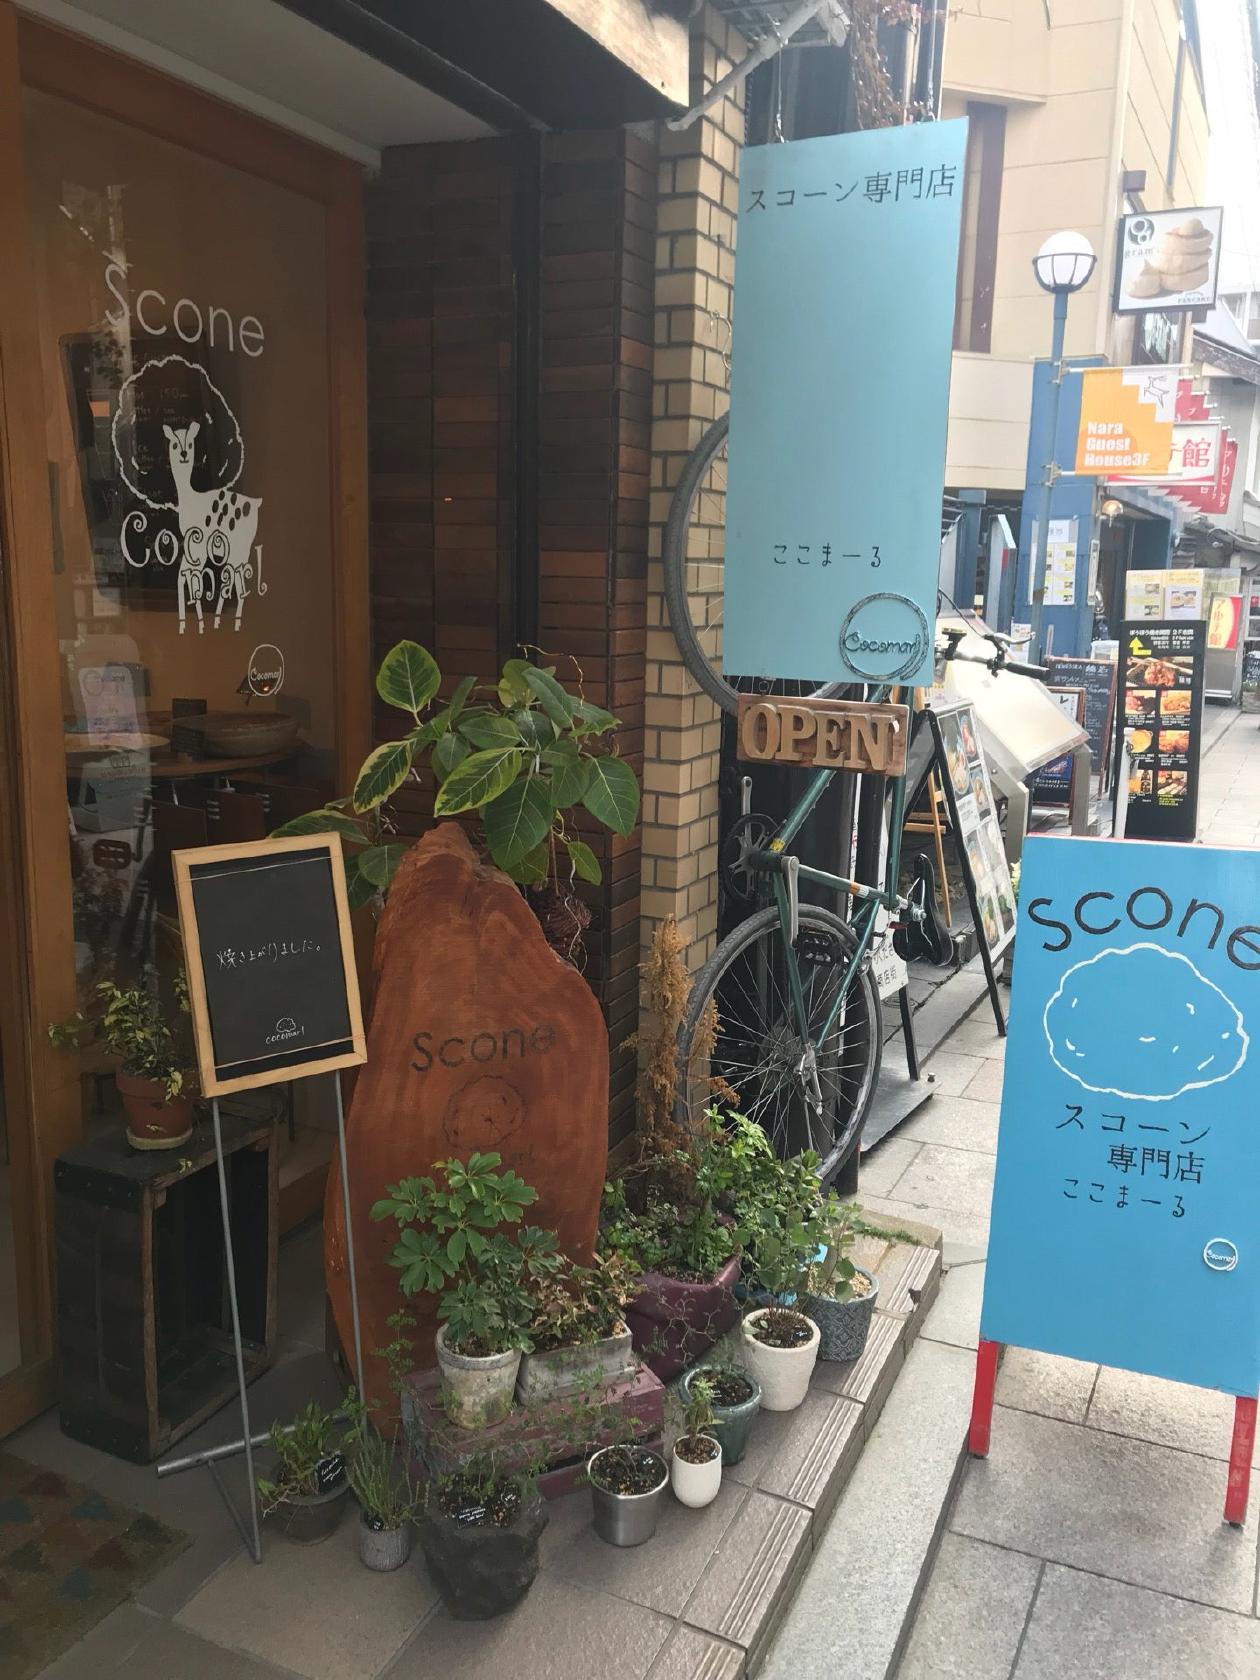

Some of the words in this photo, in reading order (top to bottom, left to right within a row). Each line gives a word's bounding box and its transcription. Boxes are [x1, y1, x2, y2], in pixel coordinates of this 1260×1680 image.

[746, 163, 957, 214] スコーン専門店
[104, 263, 264, 357] Scone
[1086, 437, 1131, 451] Guest
[1087, 421, 1124, 435] Nara
[120, 511, 231, 568] Coco
[773, 542, 882, 569] ここまーる
[741, 703, 897, 771] OPEN
[216, 939, 322, 969] 焼き上がりました。
[1055, 1104, 1211, 1144] スコーン
[1107, 1143, 1206, 1185] 専門店
[1062, 1179, 1187, 1218] ここまーる
